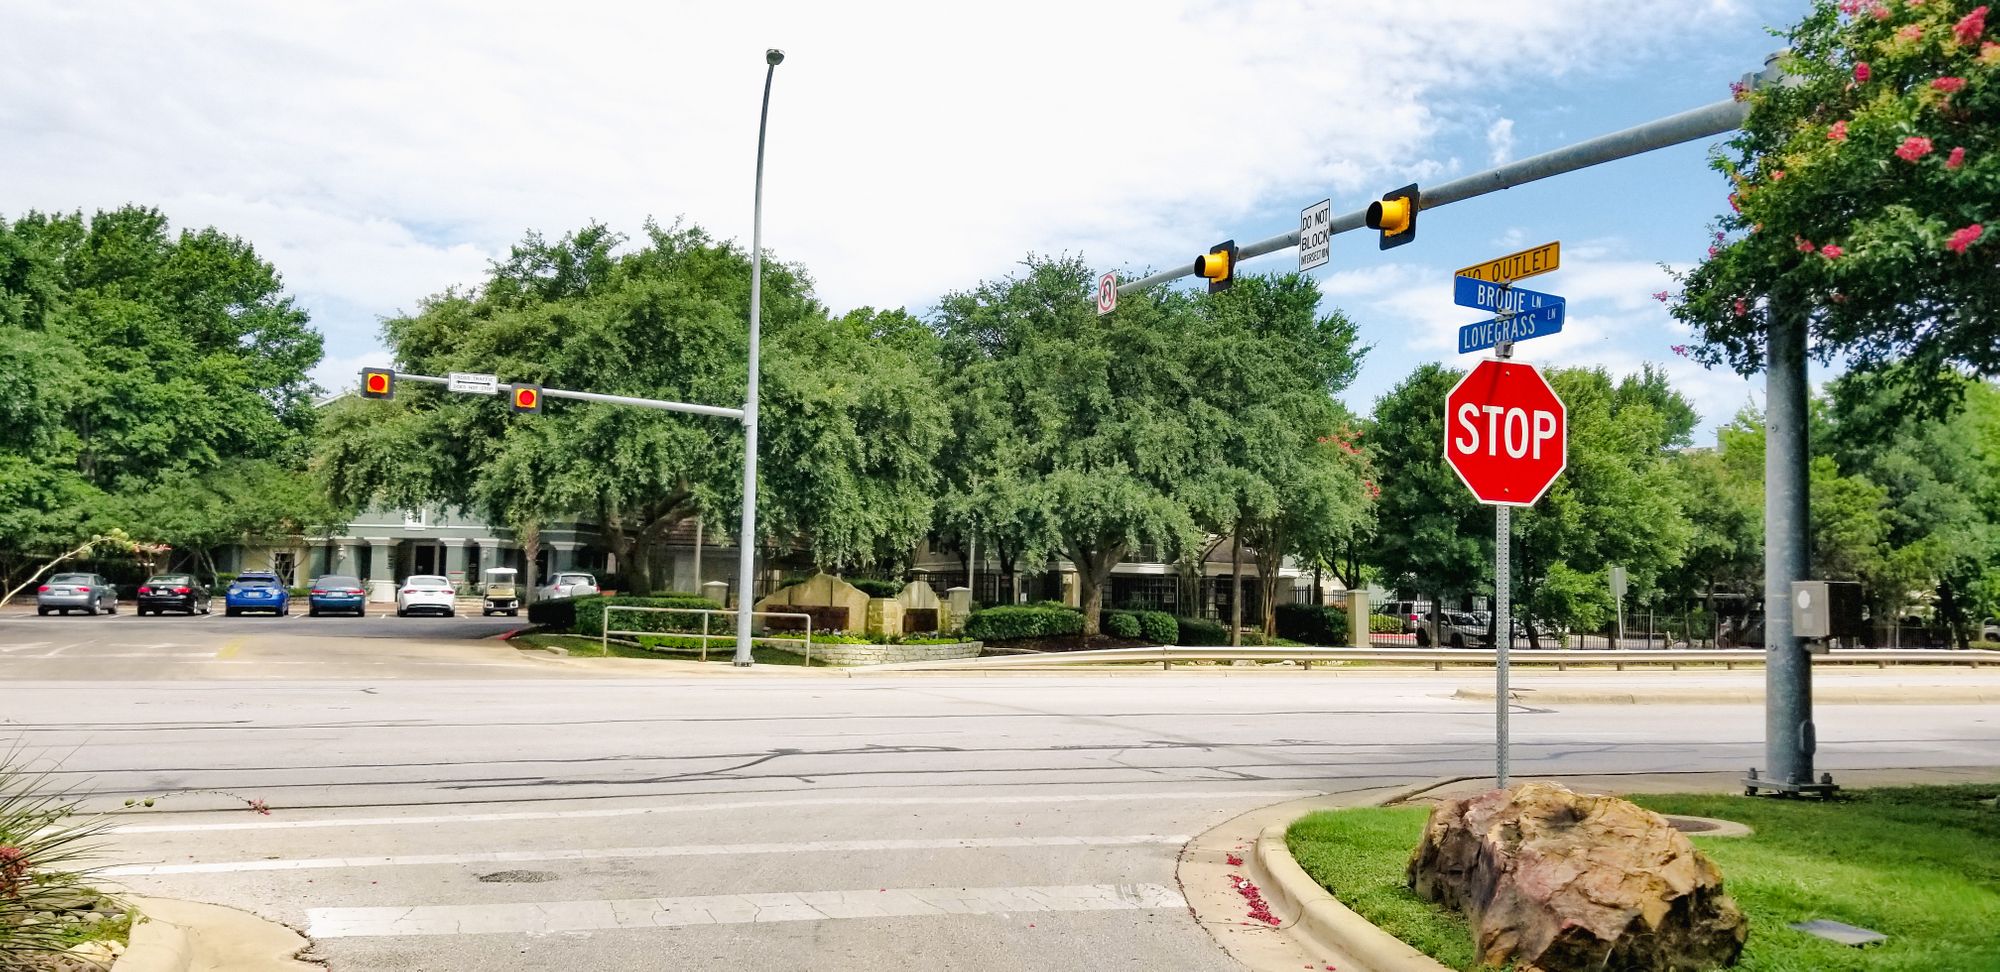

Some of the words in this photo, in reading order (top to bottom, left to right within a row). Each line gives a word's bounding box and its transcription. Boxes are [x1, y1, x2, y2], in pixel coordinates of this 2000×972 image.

[1302, 215, 1312, 232] DO
[1315, 208, 1329, 226] NOT
[1302, 228, 1329, 252] BLOCK
[1491, 247, 1551, 283] OUTLET
[1477, 284, 1526, 313] BRODIE
[1531, 294, 1542, 309] LN
[1464, 313, 1536, 349] LOVEGRASS
[1547, 307, 1556, 320] LN
[1455, 402, 1557, 460] STOP
